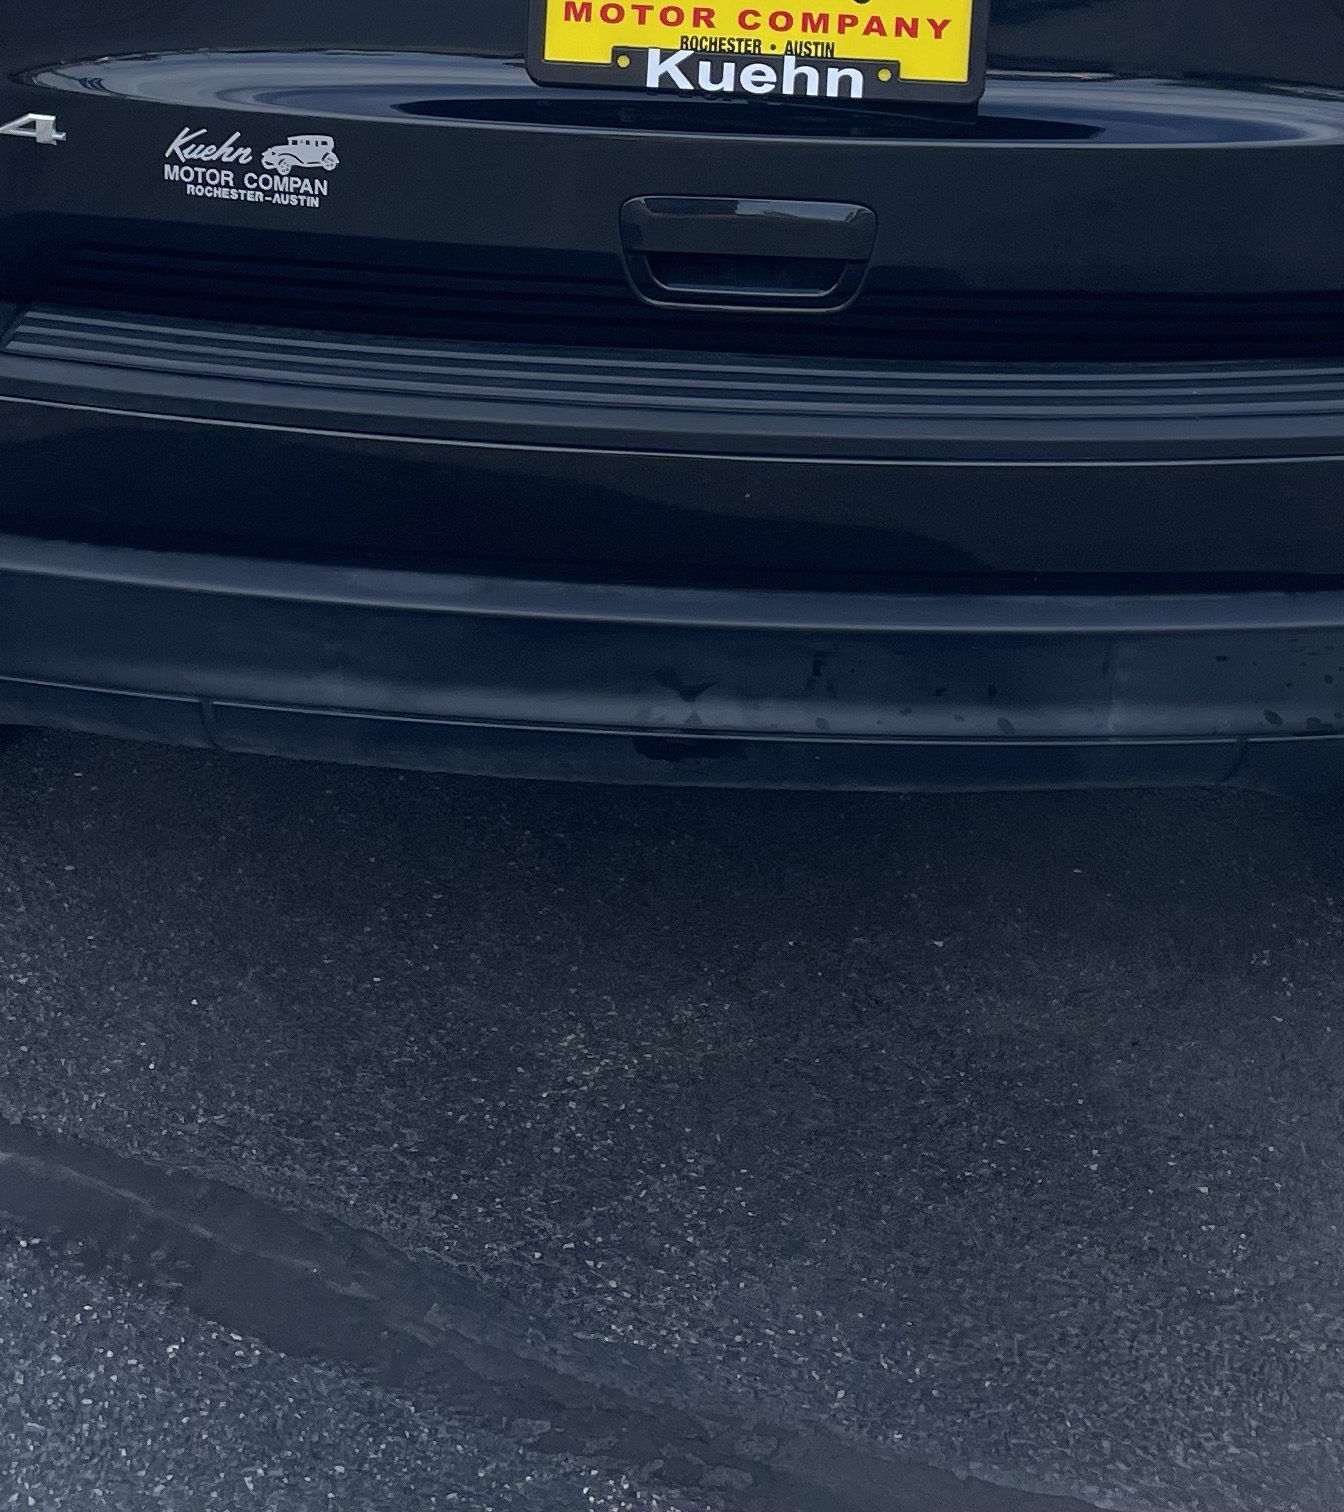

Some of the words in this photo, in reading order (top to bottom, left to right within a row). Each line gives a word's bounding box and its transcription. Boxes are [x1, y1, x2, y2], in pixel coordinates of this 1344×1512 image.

[563, 1, 717, 29] MOTOR
[737, 9, 953, 40] COMPANY
[679, 35, 763, 55] ROCHESTER
[784, 40, 835, 58] AUSTIN
[644, 48, 865, 99] Kuehn
[164, 126, 253, 164] Kuehn
[164, 165, 235, 186] MOTOR
[243, 172, 328, 195] COMPAN
[186, 185, 319, 207] ROCHESTER-AUSTIN
